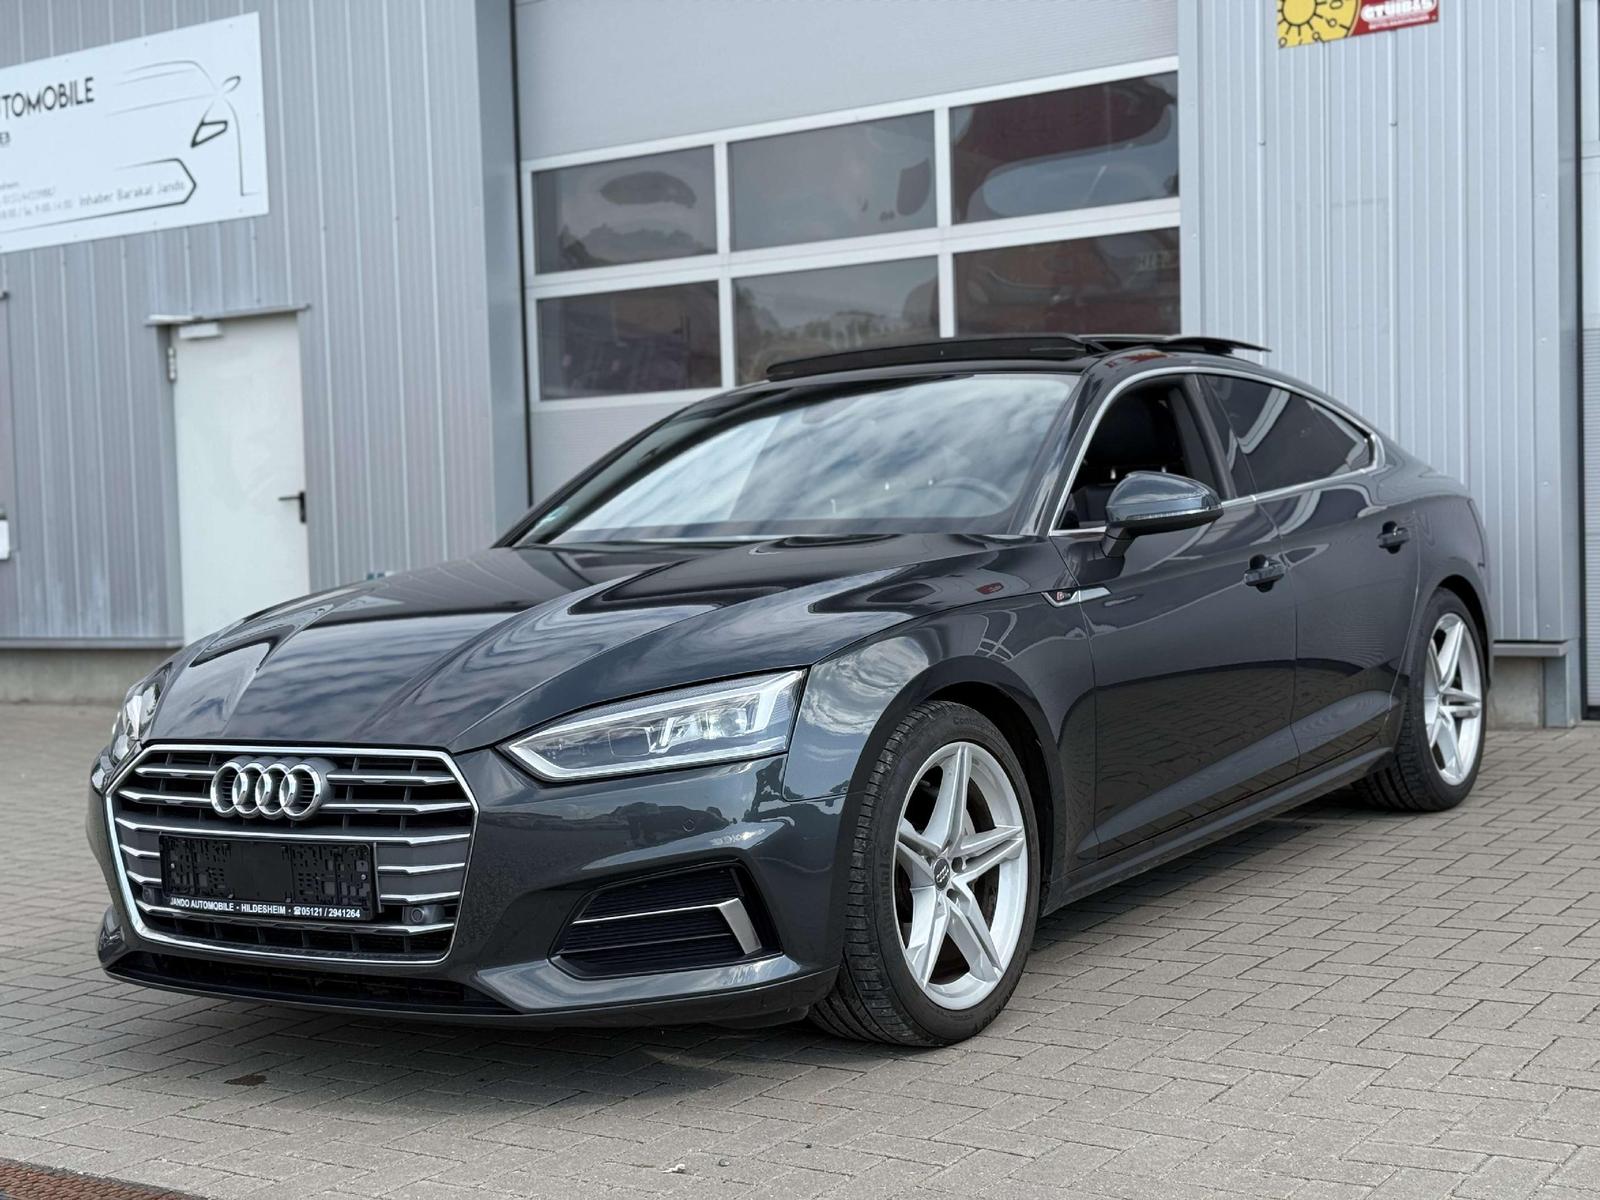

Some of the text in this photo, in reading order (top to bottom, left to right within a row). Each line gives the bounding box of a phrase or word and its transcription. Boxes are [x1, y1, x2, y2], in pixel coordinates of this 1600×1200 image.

[0, 76, 94, 121] TOMOBILE
[170, 897, 190, 908] JANDO
[191, 899, 234, 912] AUTOMOBILE
[241, 903, 286, 915] HILDESHEIM
[301, 906, 322, 917] 05121
[328, 908, 361, 918] 2941264
